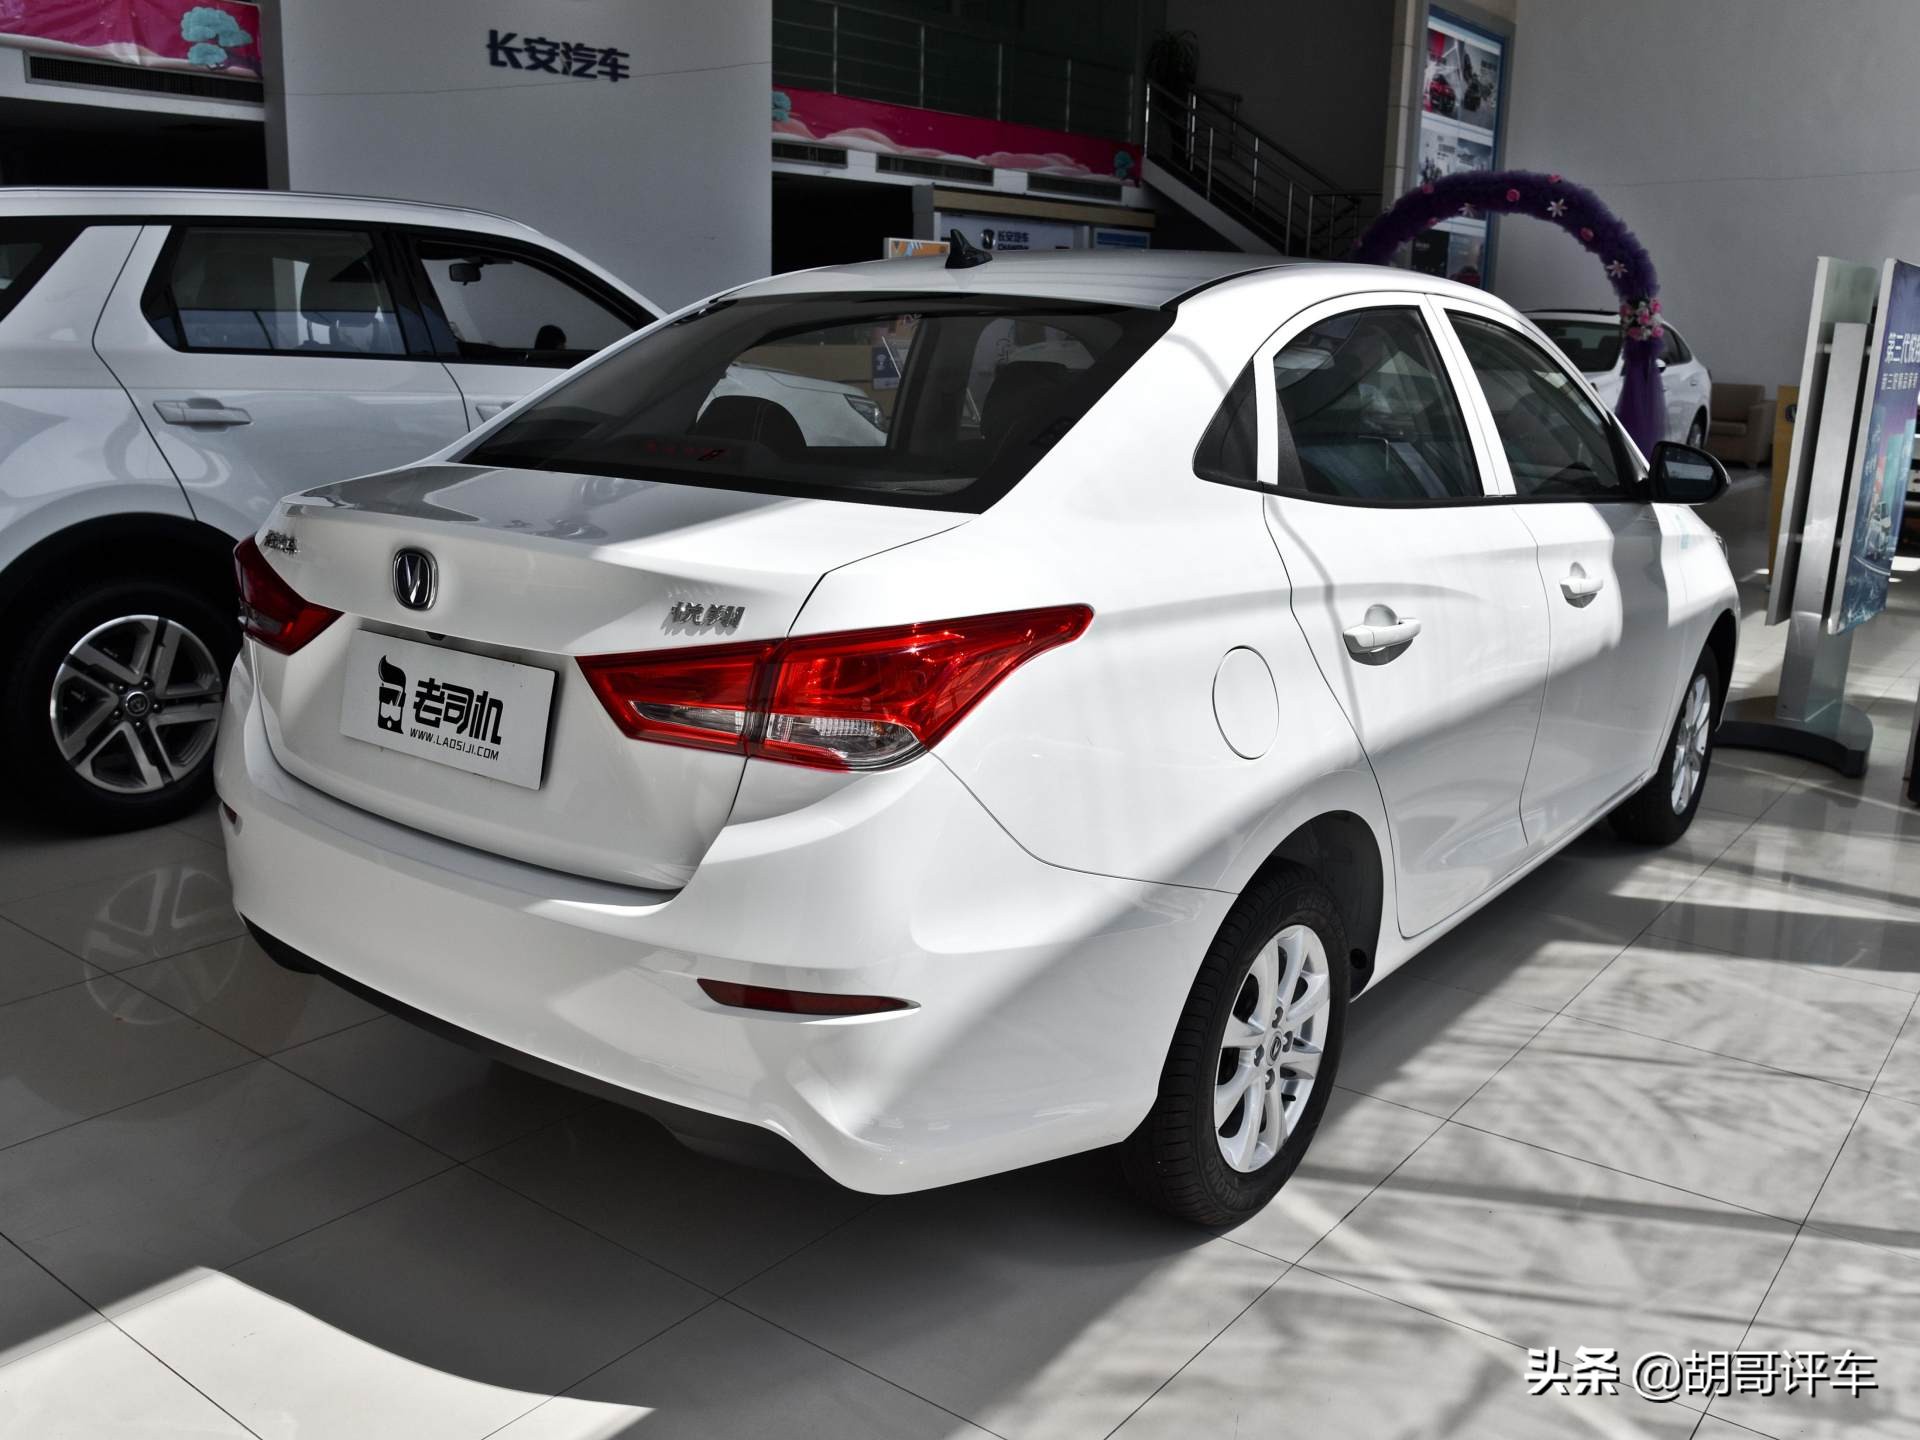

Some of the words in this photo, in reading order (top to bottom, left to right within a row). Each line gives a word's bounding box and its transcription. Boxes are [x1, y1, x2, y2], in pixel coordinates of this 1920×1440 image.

[486, 29, 631, 82] 长安汽车
[413, 677, 504, 745] 老司机
[410, 727, 499, 761] WWW.LAOSIJI.COM
